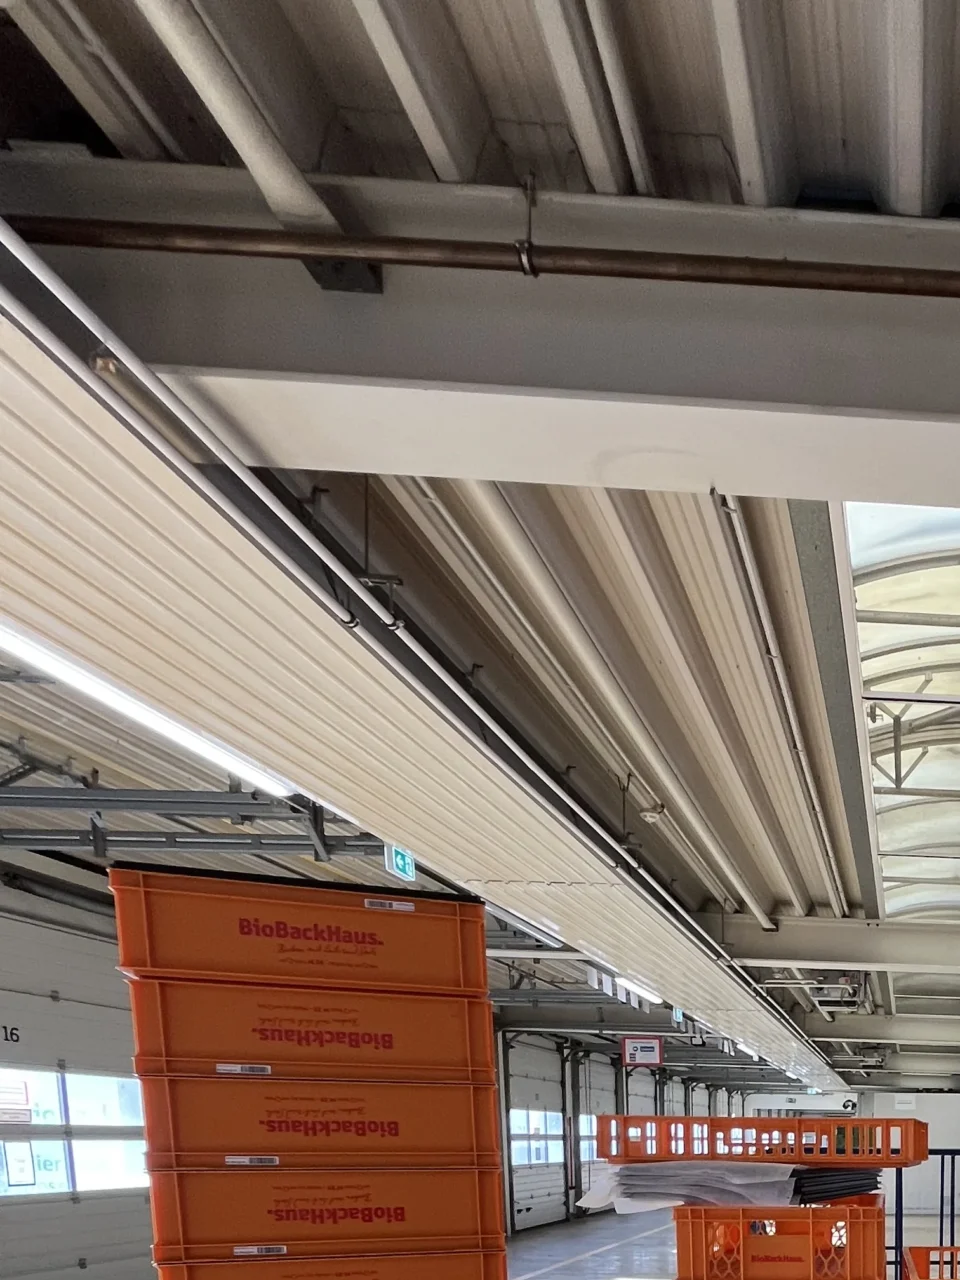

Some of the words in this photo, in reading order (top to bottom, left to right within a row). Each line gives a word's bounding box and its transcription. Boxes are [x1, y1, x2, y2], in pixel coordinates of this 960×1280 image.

[238, 917, 385, 948] BioBackHaus.
[2, 1026, 20, 1043] 16
[252, 1027, 393, 1050] BioBackHaus.
[260, 1119, 399, 1136] BioBackHaus.
[36, 1153, 61, 1172] ier
[268, 1207, 405, 1223] BioBackHaus.
